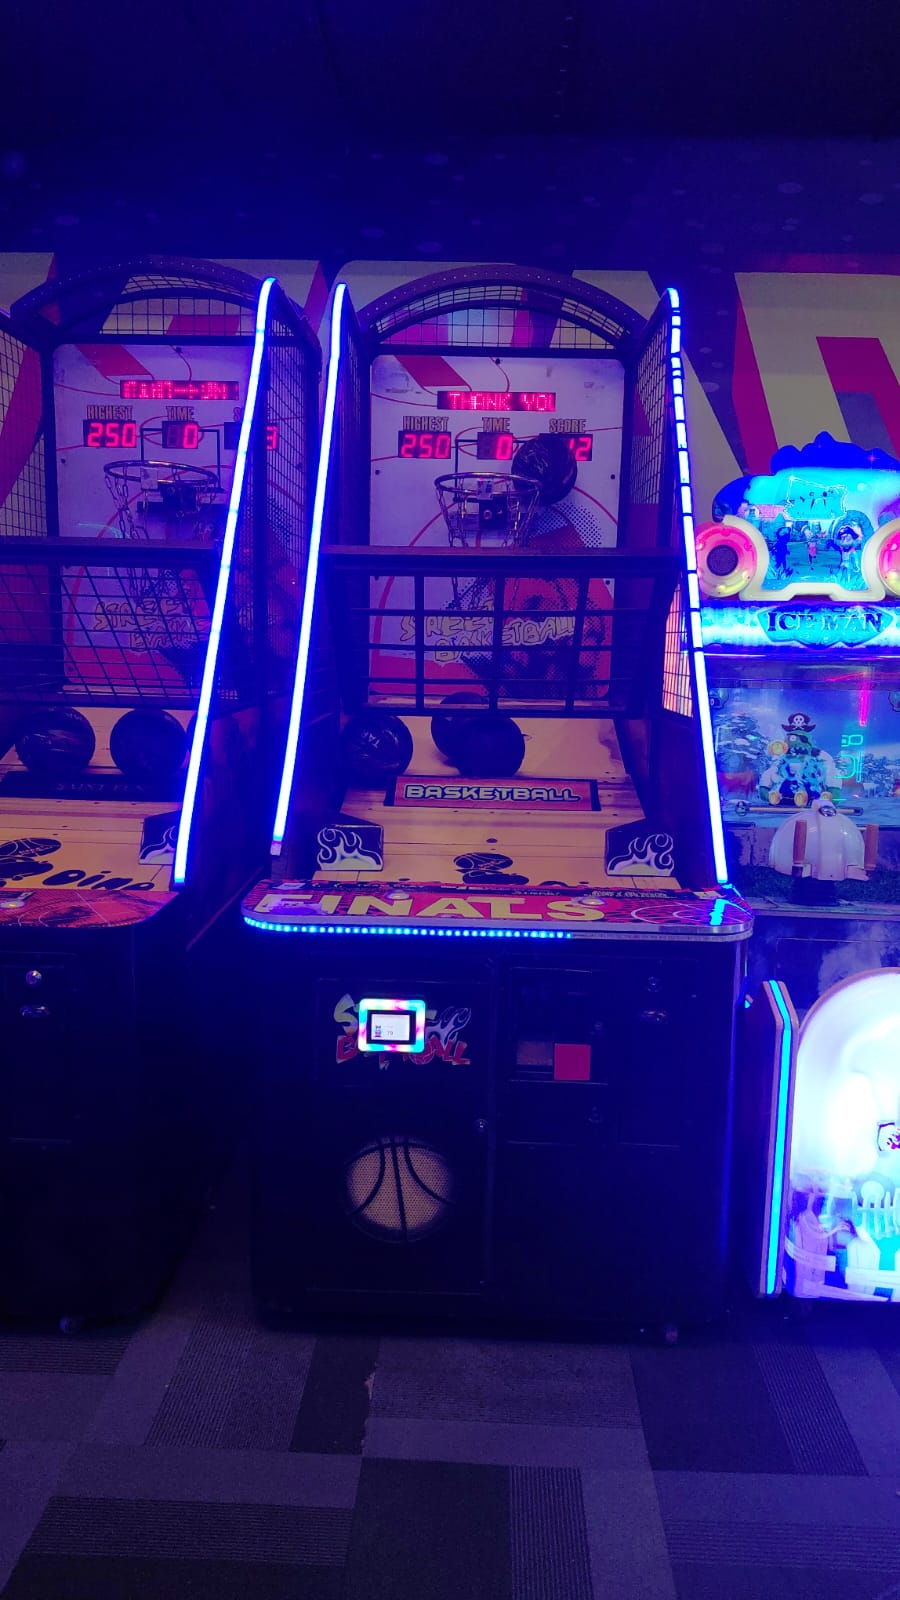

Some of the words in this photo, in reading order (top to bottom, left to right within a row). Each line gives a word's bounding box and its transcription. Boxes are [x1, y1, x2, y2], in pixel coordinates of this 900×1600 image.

[86, 405, 133, 421] HIGHEST
[166, 406, 195, 421] TIME
[402, 416, 449, 432] HIGHEST
[482, 417, 511, 432] TIME
[549, 418, 587, 434] SCORE
[87, 422, 137, 448] 250
[401, 434, 451, 459] 250
[495, 435, 513, 461] 0
[404, 783, 582, 802] BASKETBALL
